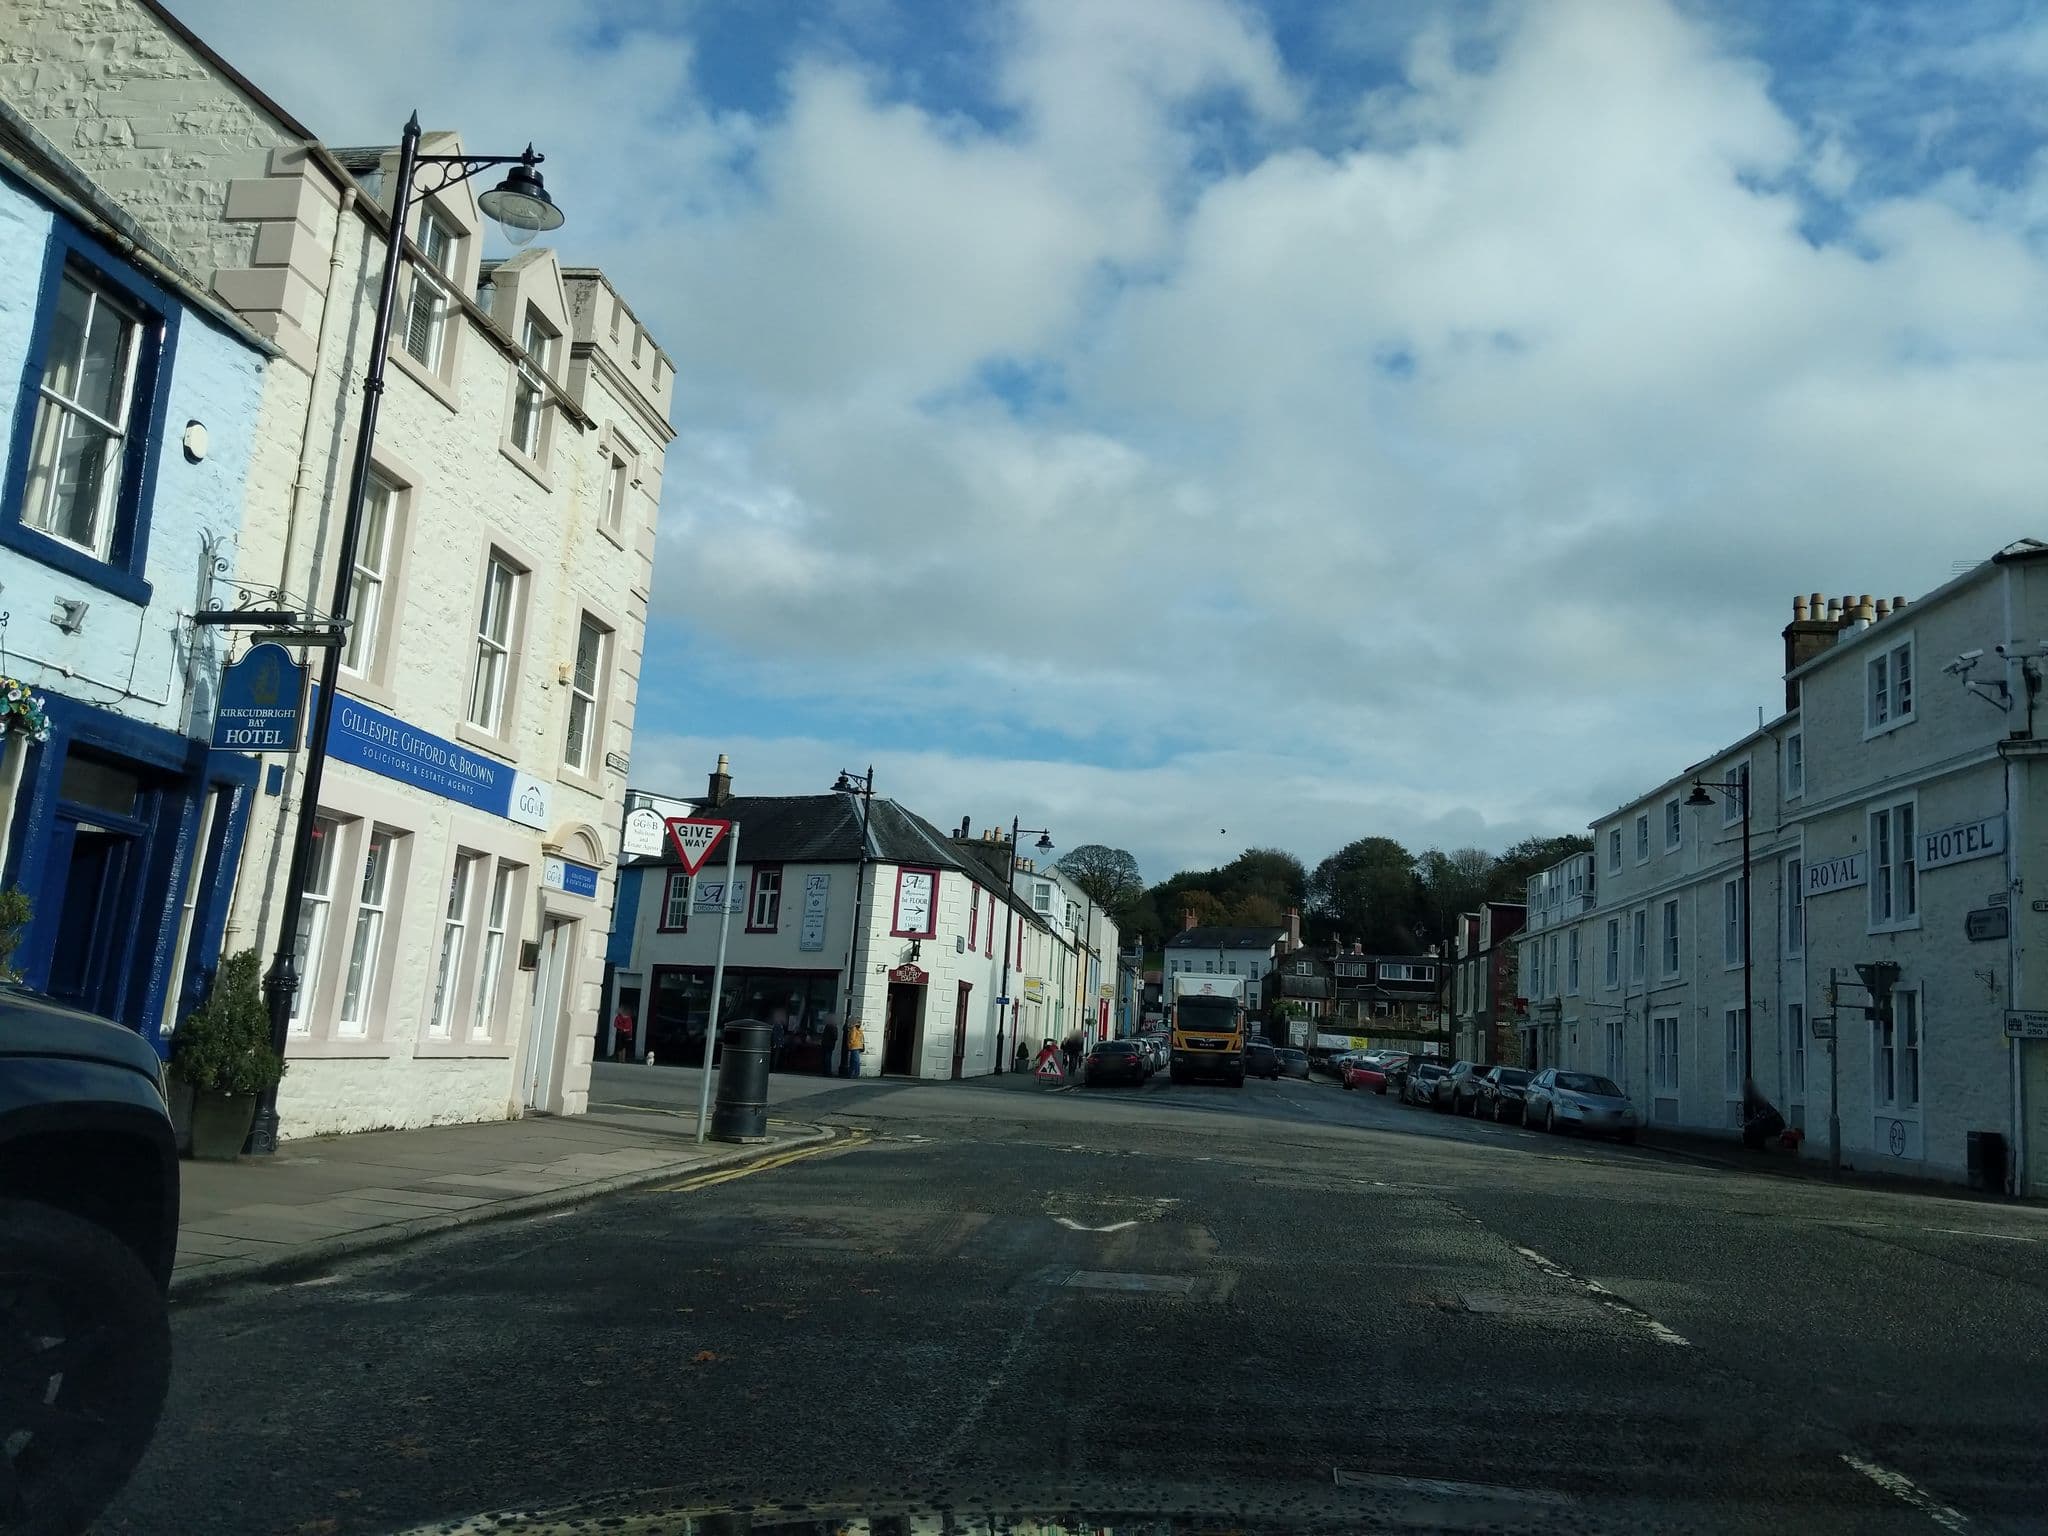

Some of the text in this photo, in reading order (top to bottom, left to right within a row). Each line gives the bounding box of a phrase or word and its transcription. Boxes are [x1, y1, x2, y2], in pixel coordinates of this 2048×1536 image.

[220, 708, 296, 718] KIRKCUDBRIGHT
[248, 719, 266, 728] BAY
[225, 729, 284, 744] HOTEL
[341, 707, 495, 785] GILLESPIE GIFFORD & BROWN
[362, 746, 474, 796] SOLICITORS & ESTATE AGENTS
[678, 825, 714, 838] GIVE
[685, 839, 707, 848] WAY
[1926, 823, 1993, 862] HOTEL
[1810, 858, 1859, 889] ROYAL
[909, 897, 928, 905] FLOOR
